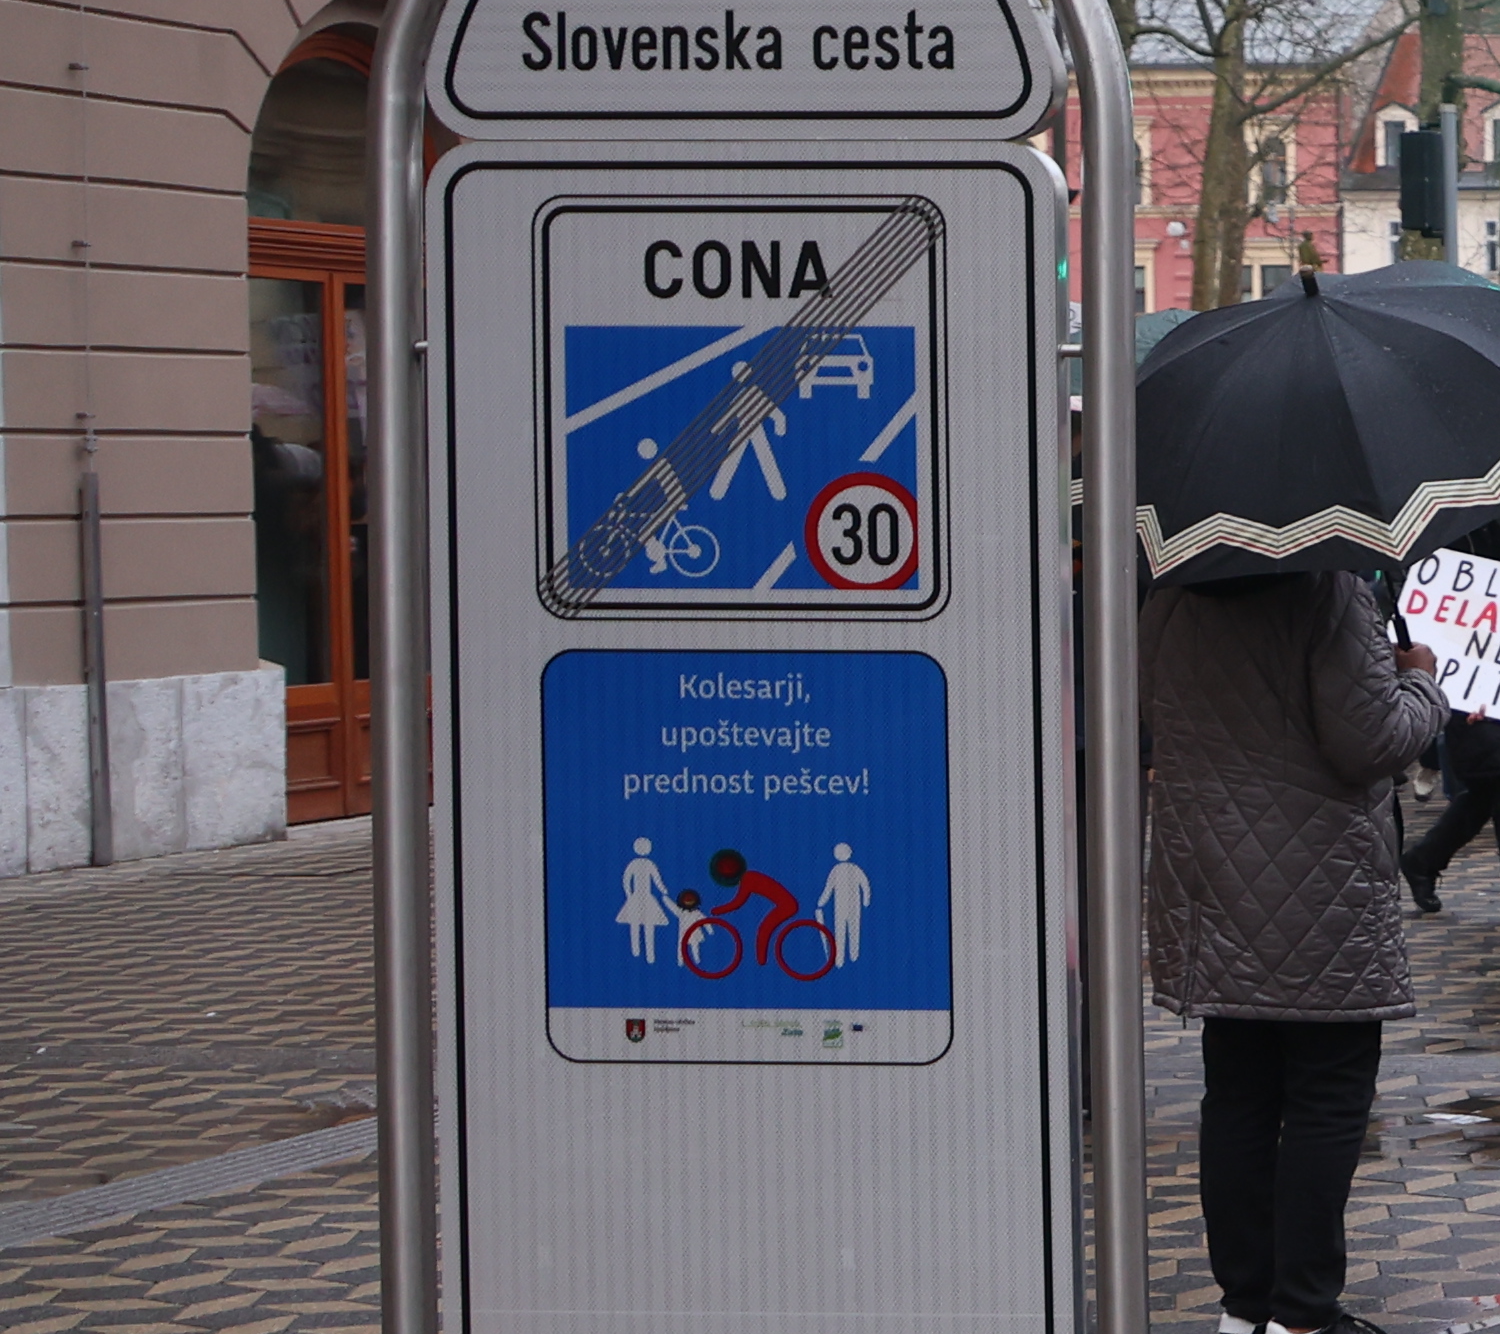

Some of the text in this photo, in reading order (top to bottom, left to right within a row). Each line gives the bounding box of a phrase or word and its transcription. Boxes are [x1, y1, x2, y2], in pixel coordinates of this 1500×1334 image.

[522, 9, 956, 72] Slovenska cesta
[643, 240, 834, 300] CONA
[831, 503, 900, 567] 30
[678, 673, 811, 707] Kolesarji,
[661, 719, 832, 753] upoštevajte
[623, 767, 870, 800] prednost pešcev!
